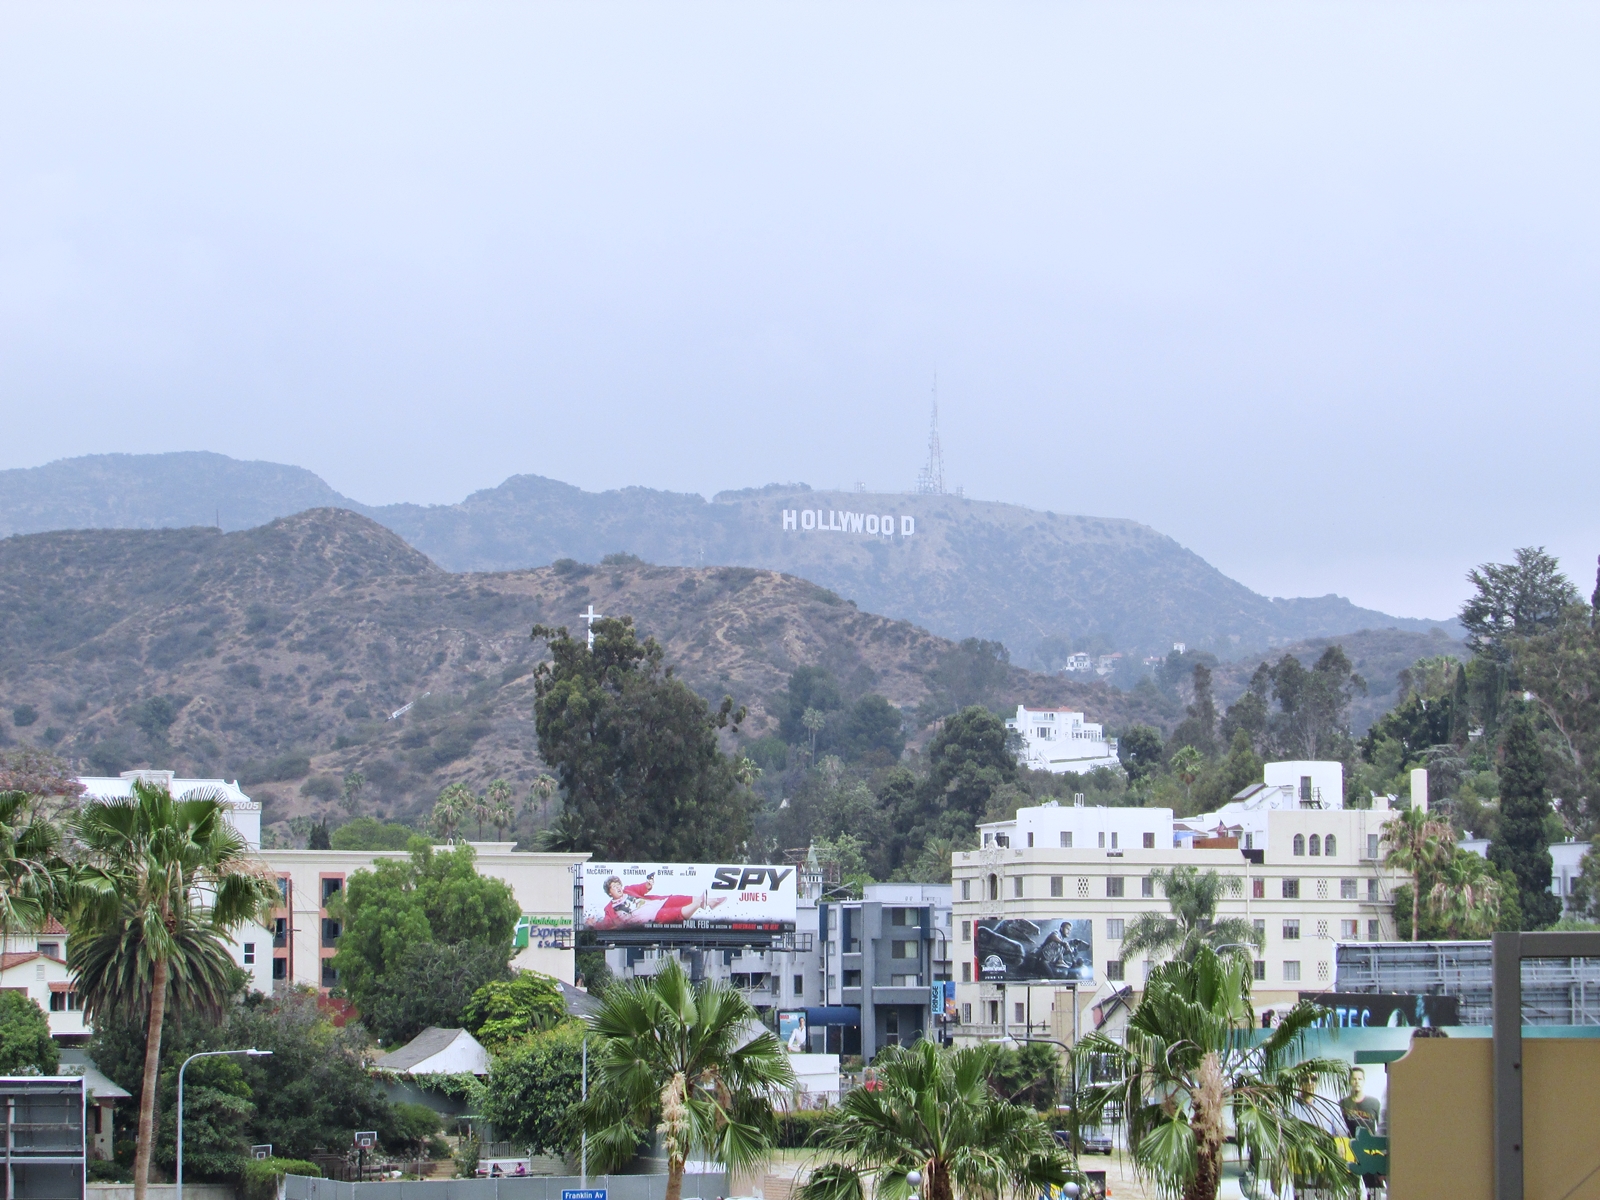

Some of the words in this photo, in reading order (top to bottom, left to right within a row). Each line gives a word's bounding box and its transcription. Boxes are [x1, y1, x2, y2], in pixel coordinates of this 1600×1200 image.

[783, 510, 915, 535] HOLLYWOOD
[233, 802, 259, 810] 2005
[711, 867, 793, 891] SPY
[739, 892, 759, 902] JUNE
[761, 892, 767, 902] 5
[530, 916, 559, 927] Holiday
[683, 920, 696, 929] PAUL
[697, 920, 710, 929] FEIG
[530, 925, 572, 939] Express
